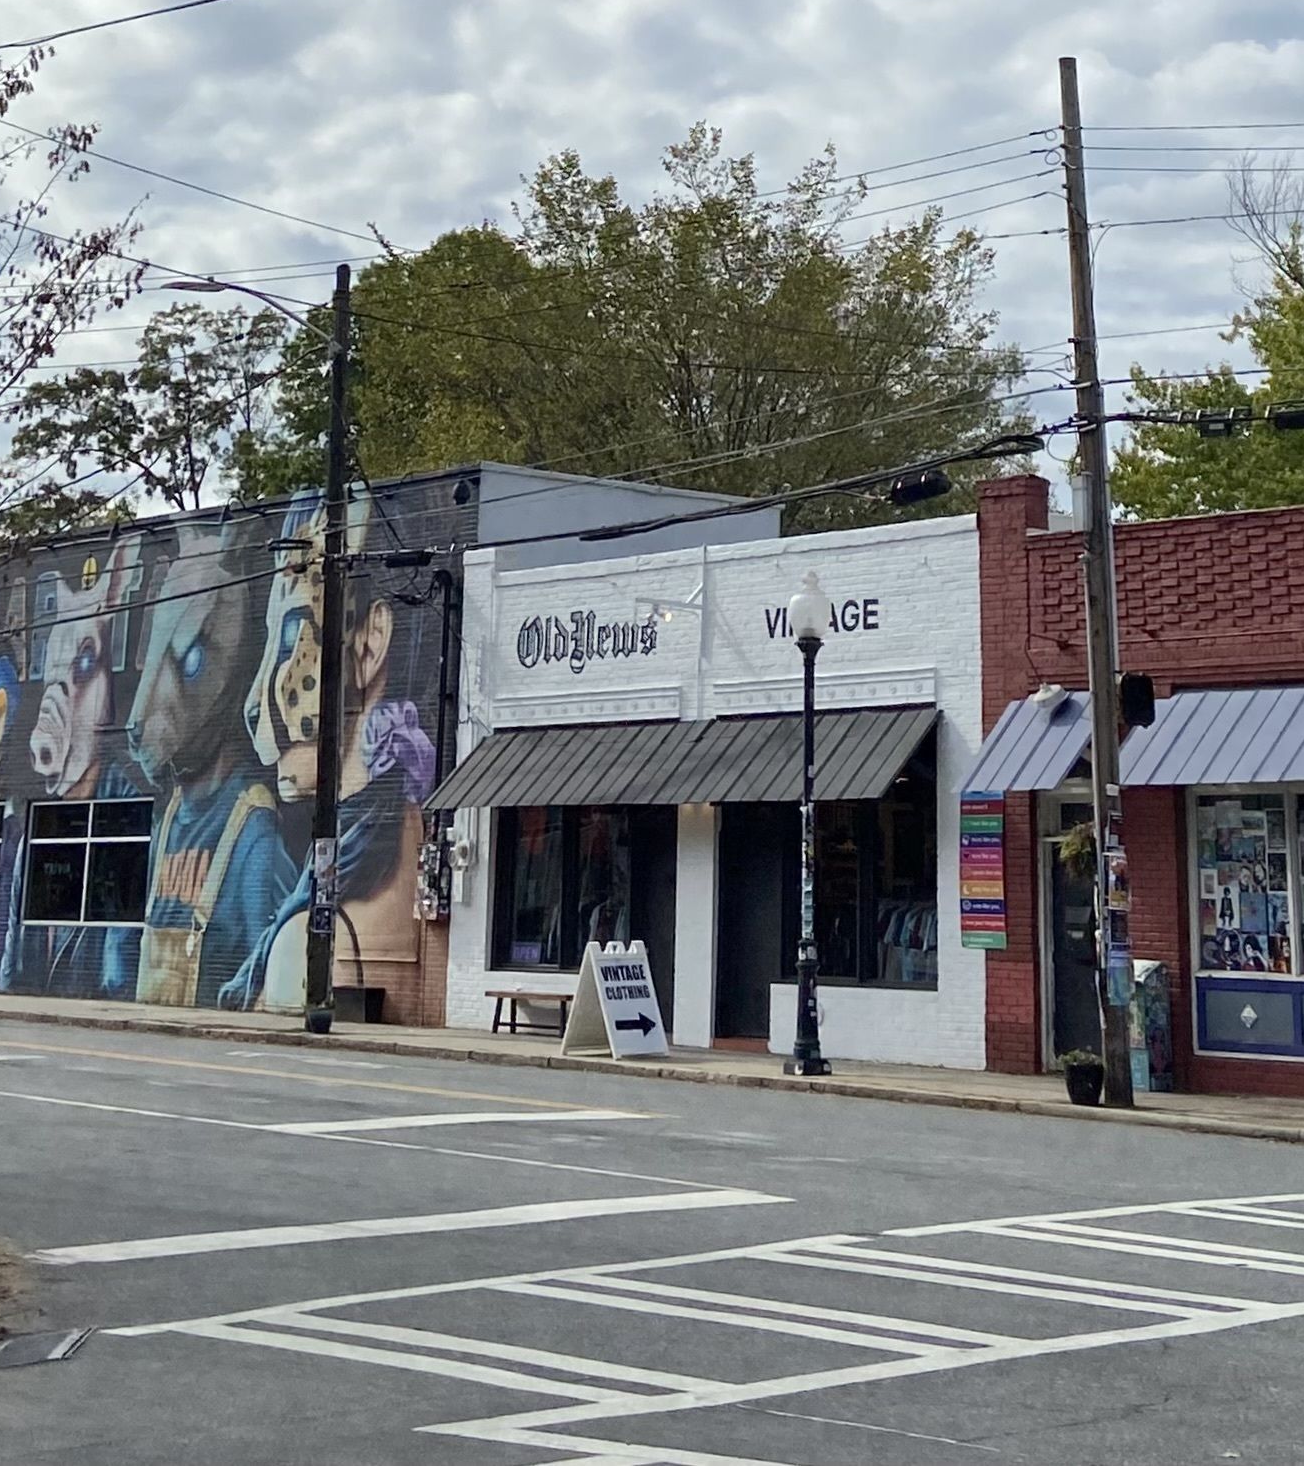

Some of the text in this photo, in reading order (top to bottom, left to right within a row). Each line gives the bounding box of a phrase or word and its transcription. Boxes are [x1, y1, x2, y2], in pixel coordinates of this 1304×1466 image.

[765, 599, 879, 639] VIAGE
[601, 965, 646, 981] VINTAGE
[605, 986, 650, 1000] CLOTHING
